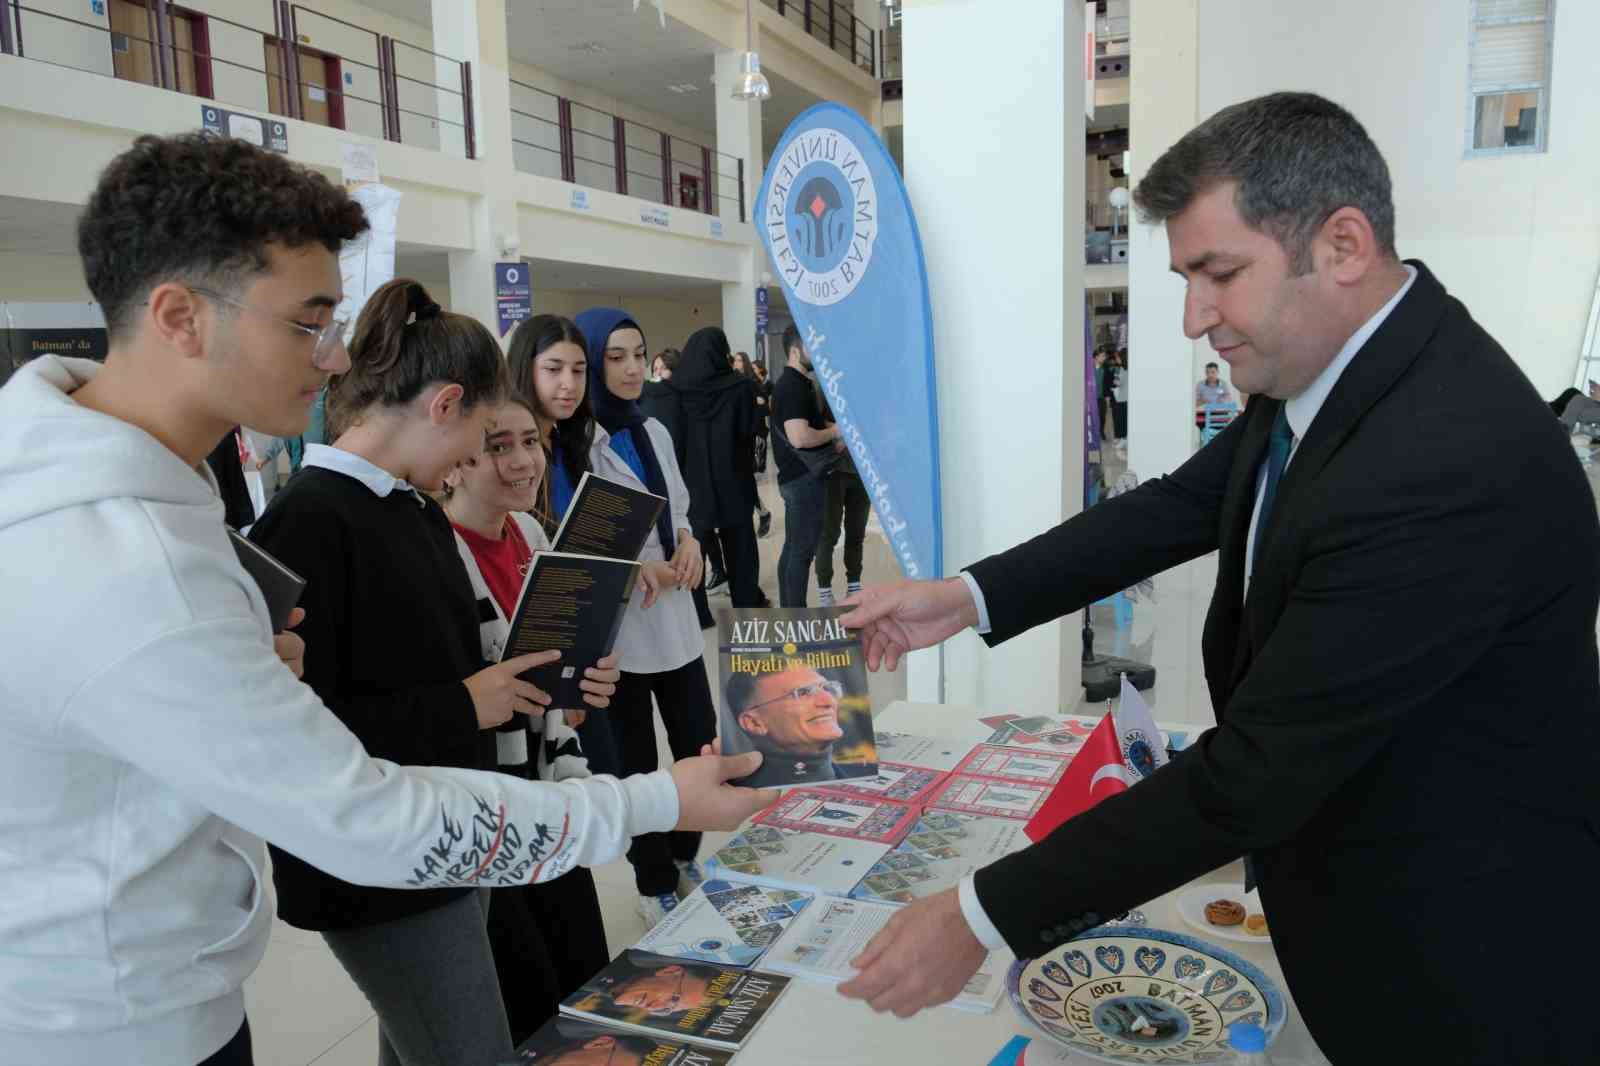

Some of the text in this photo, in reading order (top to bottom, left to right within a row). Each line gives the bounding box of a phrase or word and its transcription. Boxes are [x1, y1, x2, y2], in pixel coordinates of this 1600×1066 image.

[731, 617, 848, 644] AZİZ SANCAR
[806, 650, 850, 669] Bilimi
[406, 800, 463, 885] MAKE
[1090, 981, 1125, 999] 2007
[1148, 983, 1213, 1036] BATMAN
